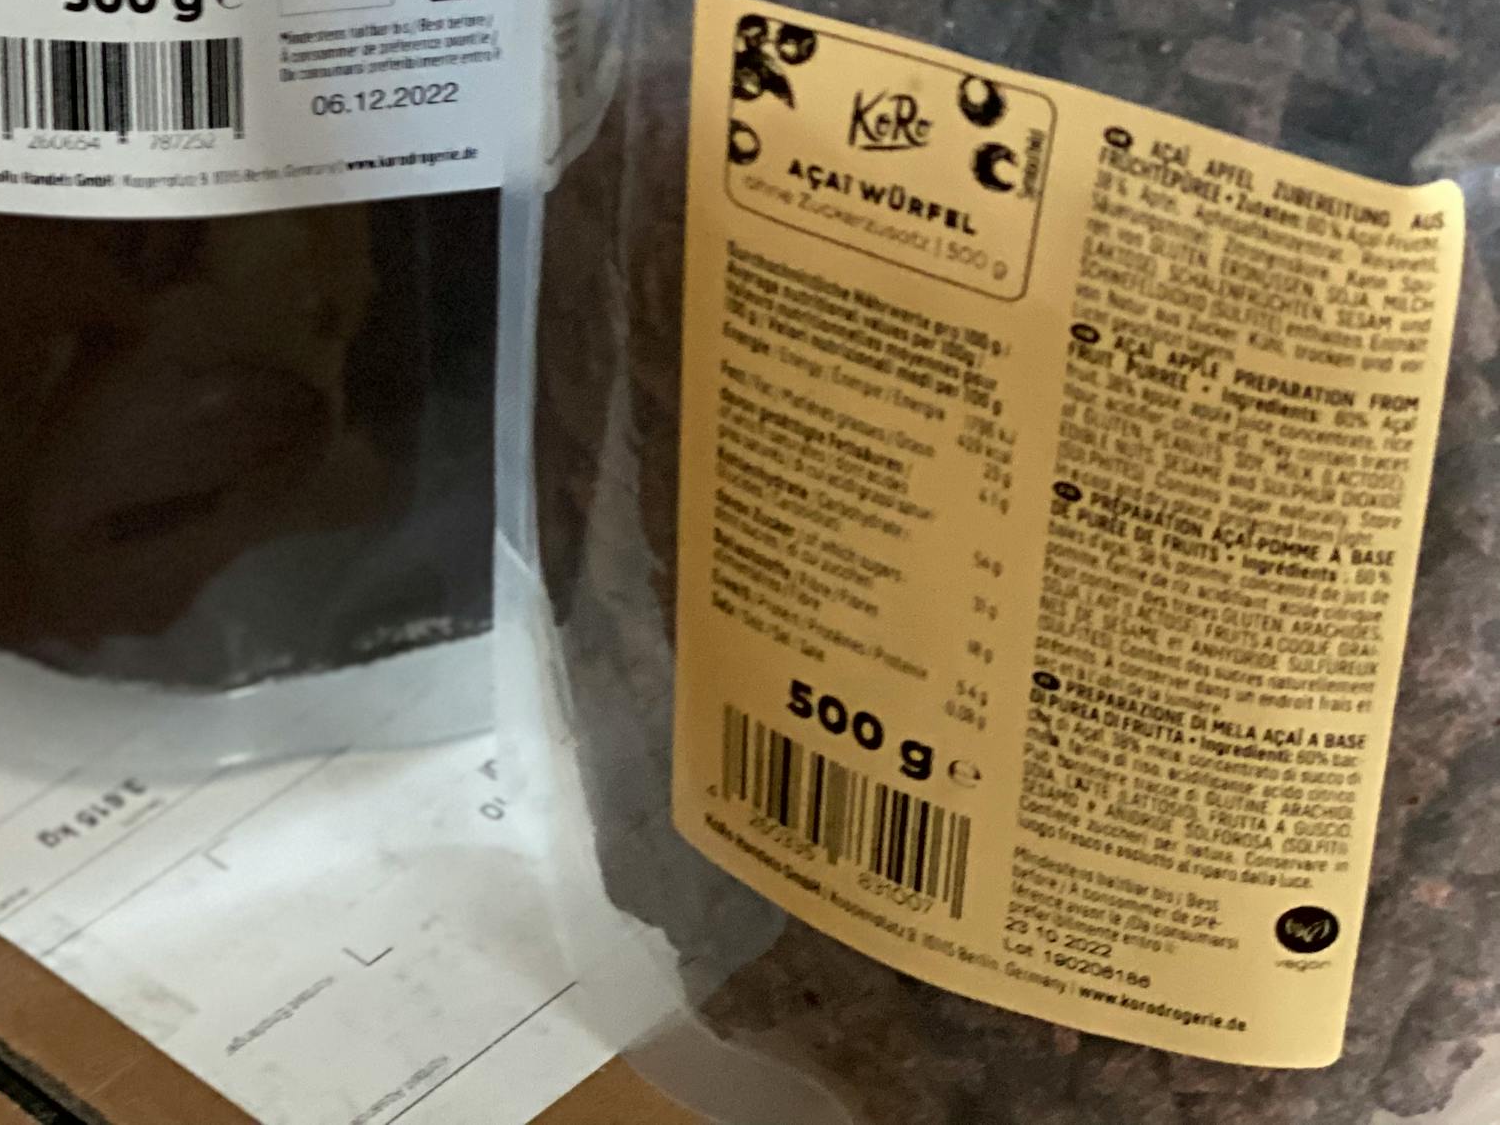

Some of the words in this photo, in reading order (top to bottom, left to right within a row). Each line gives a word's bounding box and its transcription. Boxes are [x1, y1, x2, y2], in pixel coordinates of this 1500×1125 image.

[311, 81, 459, 116] 06.12.2022
[848, 92, 931, 152] KoRo
[860, 182, 975, 236] WÜRFEL
[1166, 351, 1219, 380] APPLE
[1233, 368, 1355, 413] PREPARATION
[1369, 393, 1420, 419] FROM
[1049, 498, 1072, 519] DE
[1133, 525, 1155, 545] DE
[1161, 533, 1222, 562] FRUITS
[1350, 543, 1395, 567] BASE
[787, 680, 885, 751] 500
[899, 739, 934, 782] g
[1029, 687, 1046, 705] DI
[1102, 710, 1121, 729] DI
[1121, 716, 1185, 745] FRUTTA
[1062, 680, 1190, 727] PREPARAZIONE
[1189, 714, 1208, 732] DI
[1211, 719, 1257, 741] MELA
[1307, 732, 1319, 748] A
[1323, 732, 1367, 750] BASE
[37, 823, 77, 850] kg
[1208, 803, 1268, 832] FRUTTA
[1244, 845, 1329, 873] Conservare
[1079, 987, 1247, 1032] www.korodrogerie.de
